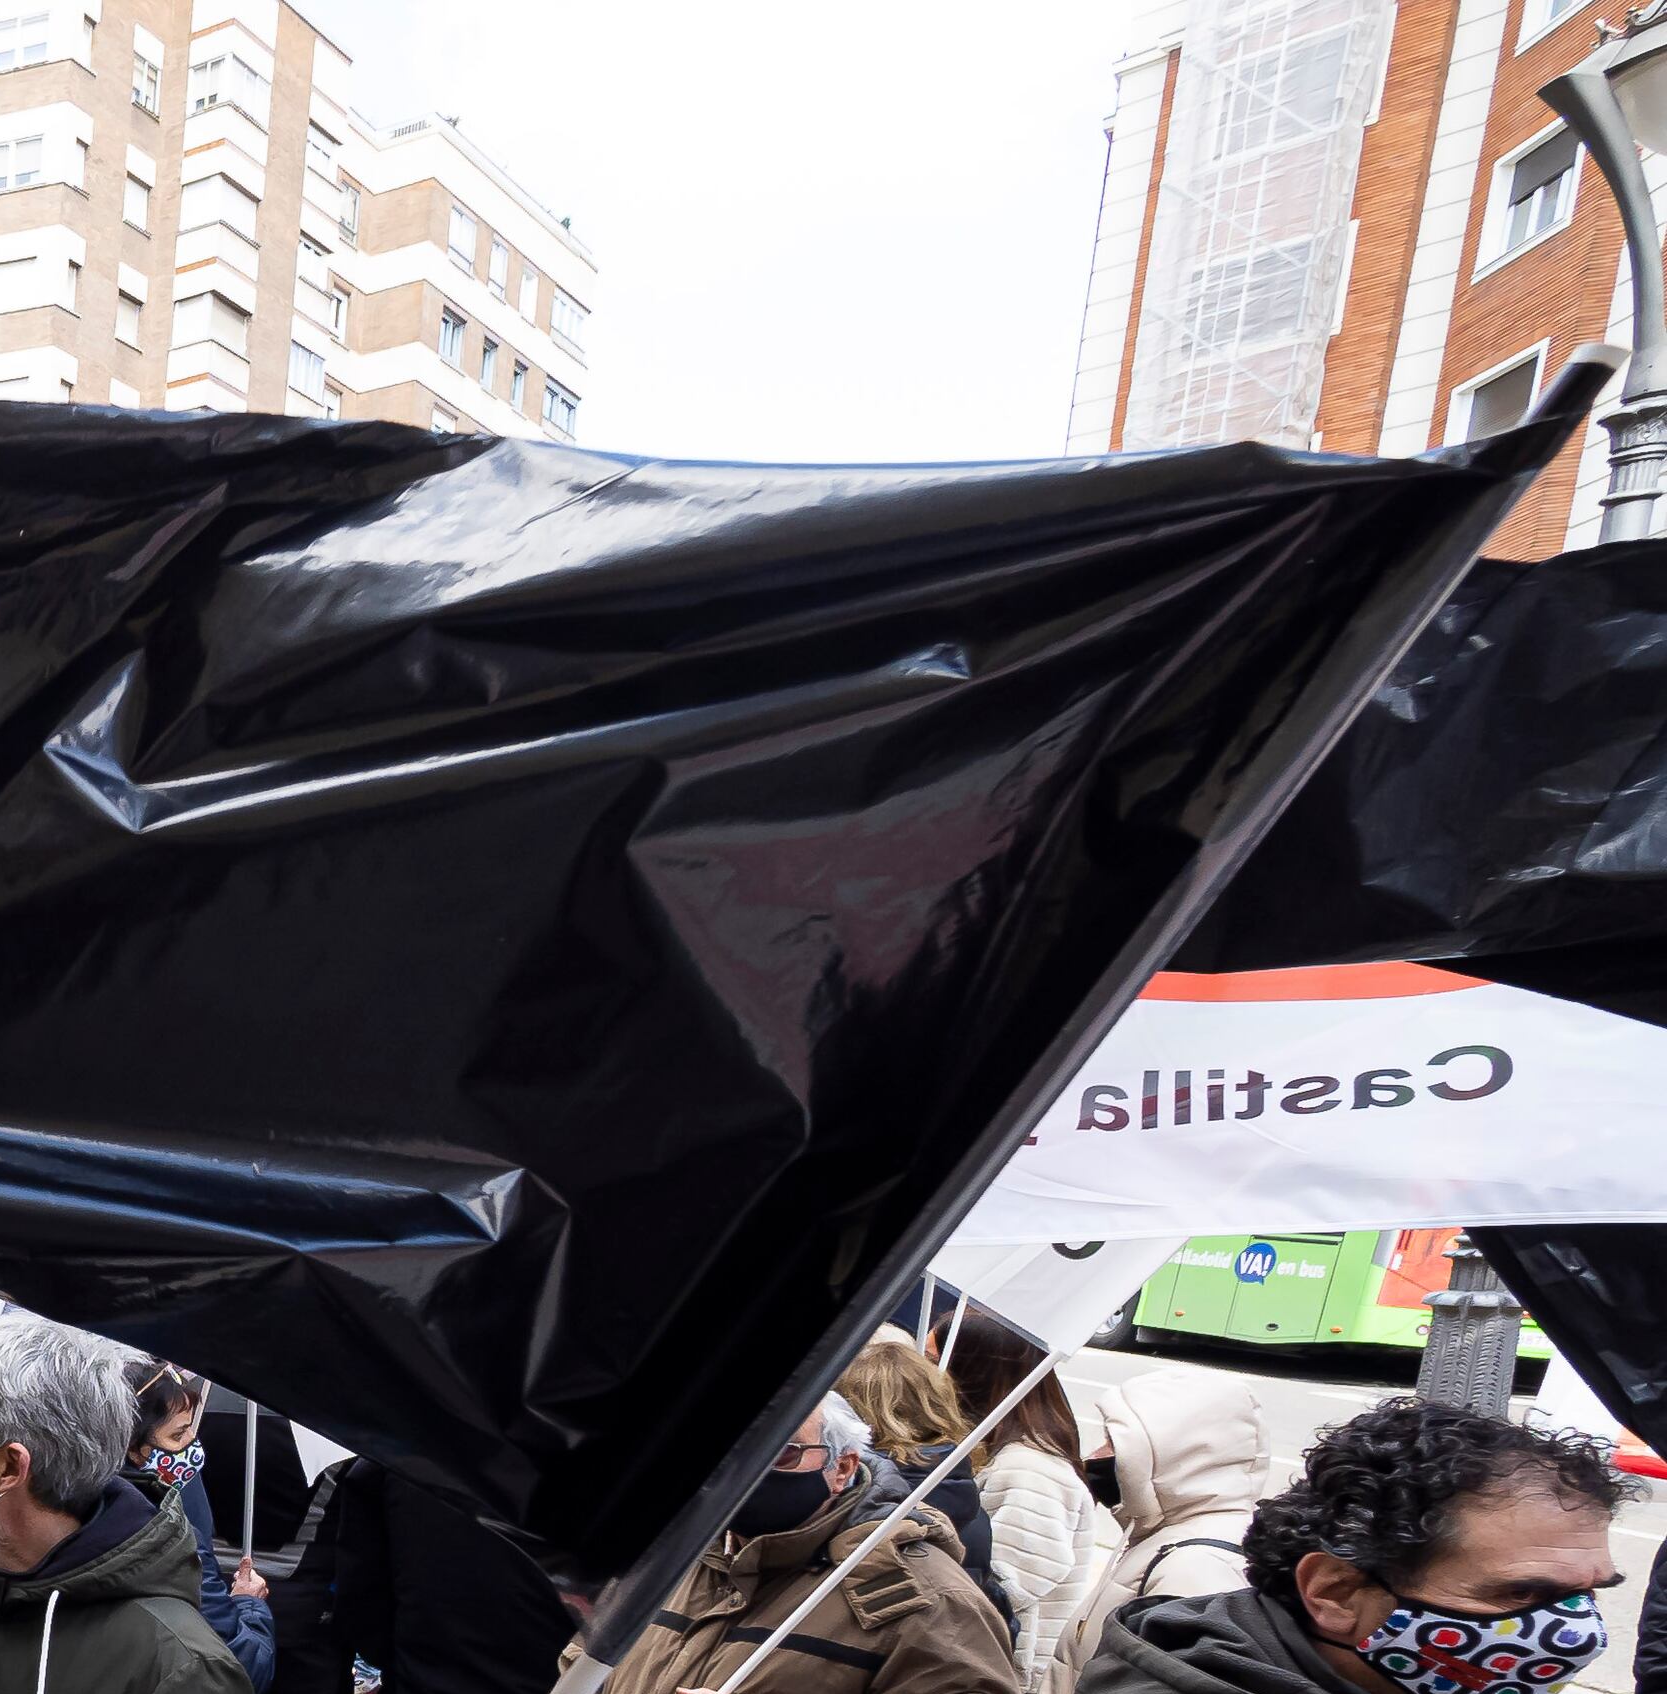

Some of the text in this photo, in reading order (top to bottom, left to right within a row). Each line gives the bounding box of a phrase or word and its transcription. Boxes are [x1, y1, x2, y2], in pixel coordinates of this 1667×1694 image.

[1239, 1251, 1273, 1277] VA!
[1277, 1261, 1297, 1276] en
[1298, 1260, 1328, 1279] bus
